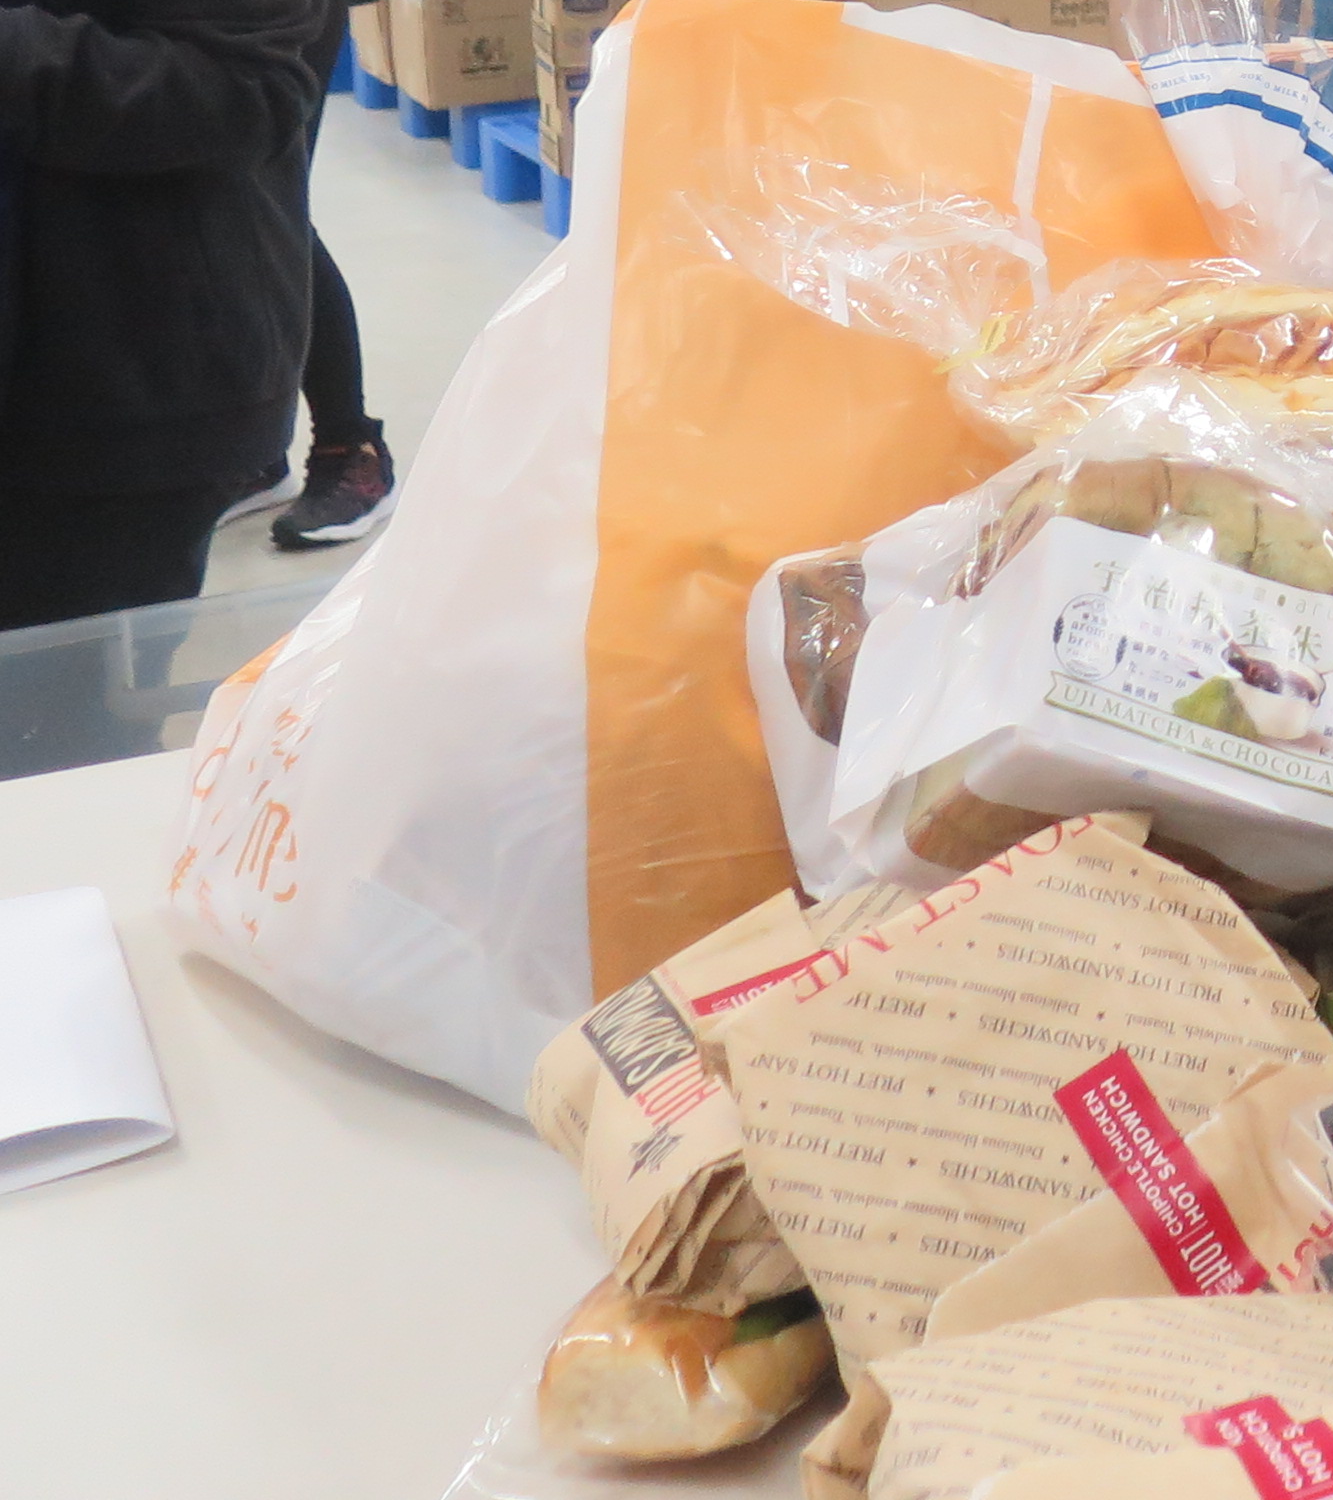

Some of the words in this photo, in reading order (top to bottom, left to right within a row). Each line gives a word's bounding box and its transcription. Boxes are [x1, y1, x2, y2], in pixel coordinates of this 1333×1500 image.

[1063, 684, 1097, 708] UJI
[1099, 698, 1197, 749] MATCHA
[1201, 732, 1215, 750] &
[1143, 896, 1187, 919] HOT
[1192, 905, 1240, 929] PRET
[1036, 922, 1097, 946] Delicious
[995, 941, 1126, 983] SANDWICHES
[960, 978, 1017, 1003] bloomer
[1127, 969, 1172, 993] HOT
[1175, 979, 1223, 1004] PRET
[870, 993, 925, 1019] PRET
[1018, 990, 1081, 1016] Delicious
[977, 1013, 1108, 1054] SANDWICHES
[800, 1059, 850, 1085] HOT
[938, 1054, 996, 1079] bloomer
[1160, 1048, 1208, 1072] PRET
[851, 1068, 905, 1094] PRET
[920, 1123, 978, 1149] bloomer
[1081, 1088, 1139, 1162] CHICKEN
[1099, 1074, 1177, 1180] SANDWICH
[780, 1130, 830, 1155] HOT
[832, 1139, 886, 1165] PRET
[980, 1133, 1044, 1160] Delicious
[938, 1156, 1073, 1199] SANDWICHES
[1125, 1156, 1185, 1238] CHIPOTLE
[1168, 1176, 1206, 1231] HOT
[900, 1199, 960, 1224] bloomer
[961, 1209, 1026, 1235] Delicious
[816, 1217, 865, 1242] PRET
[1179, 1232, 1234, 1296] HOT
